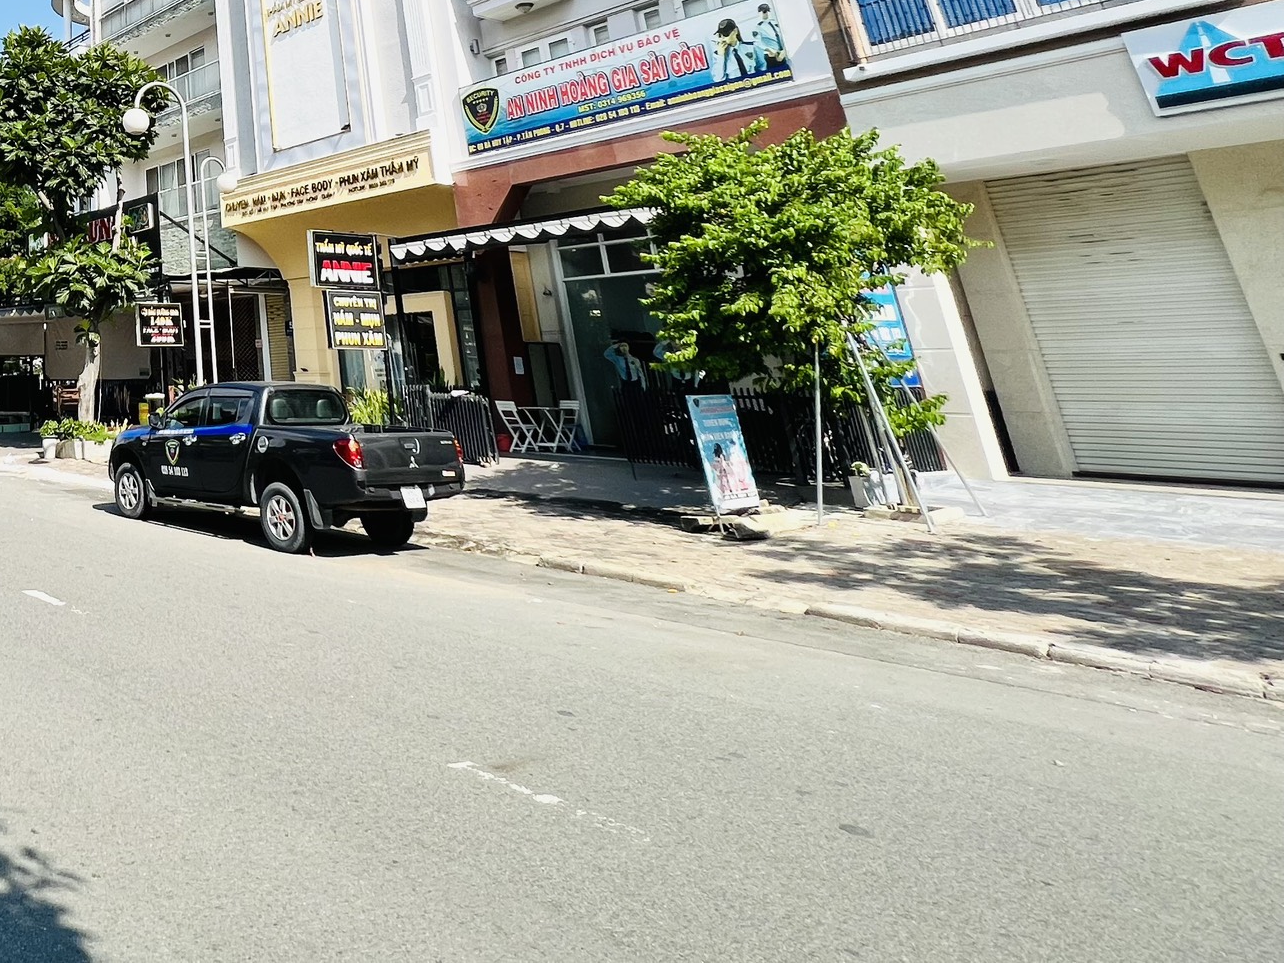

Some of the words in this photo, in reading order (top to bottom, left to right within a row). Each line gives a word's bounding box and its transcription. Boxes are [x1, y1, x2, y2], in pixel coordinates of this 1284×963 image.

[273, 2, 323, 38] ANNIE
[514, 70, 541, 84] CÔNG
[544, 63, 556, 76] TY
[558, 57, 587, 71] TNHH
[590, 48, 616, 63] DỊCH
[618, 42, 634, 54] VỤ
[637, 34, 661, 48] BẢO
[664, 28, 680, 40] VỆ
[506, 96, 525, 121] AN
[524, 85, 559, 115] NINH
[558, 71, 610, 106] HOÀNG
[611, 63, 640, 93] GIA
[669, 42, 709, 77] GÒN
[466, 90, 494, 104] SECURITY
[578, 102, 596, 113] MST:
[597, 99, 616, 109] 0314
[290, 184, 309, 197] FACE
[311, 179, 333, 193] BODY
[339, 172, 360, 187] PHUN
[315, 238, 334, 254] THẨM
[346, 241, 363, 256] QUỐC
[364, 243, 373, 256] TẾ
[321, 260, 374, 284] ANNIE
[333, 295, 364, 308] CHUYÊN
[333, 309, 354, 326] NÁM
[334, 331, 361, 345] PHUN
[362, 330, 383, 346] XĂM
